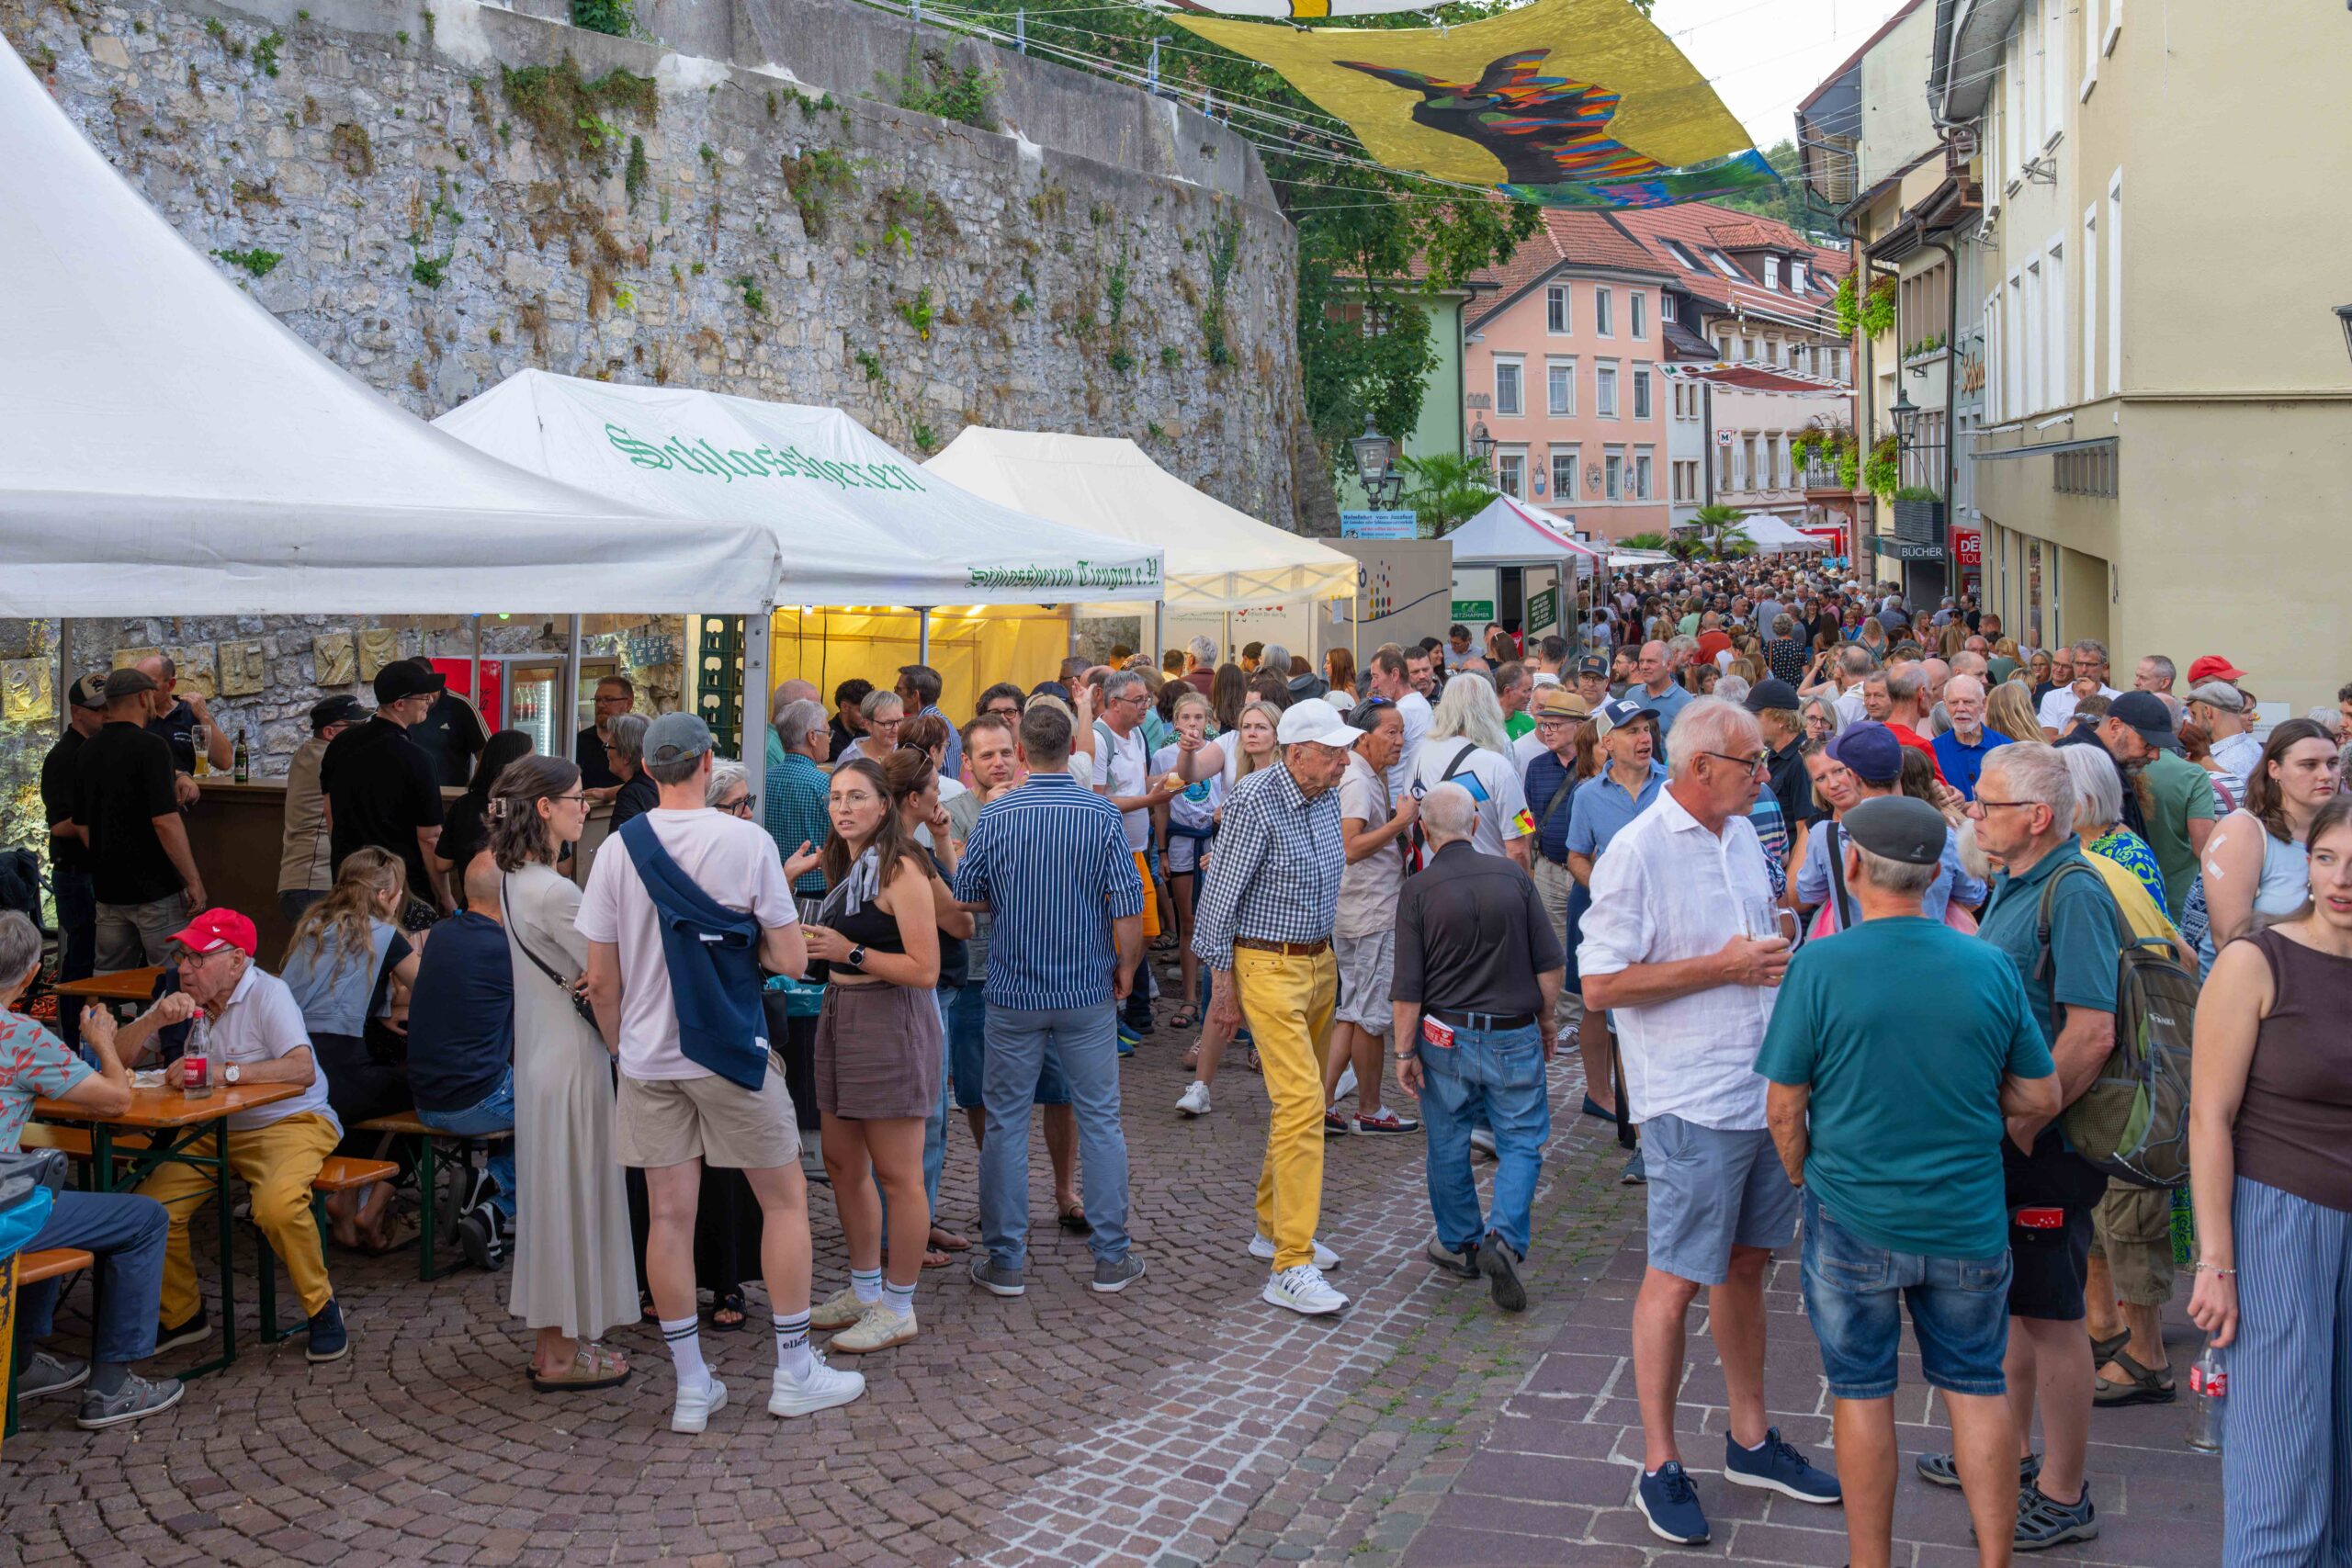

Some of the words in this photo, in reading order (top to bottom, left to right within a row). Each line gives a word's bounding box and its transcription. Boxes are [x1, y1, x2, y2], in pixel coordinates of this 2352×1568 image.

[1901, 545, 1943, 557] BÜCHER
[1961, 539, 1981, 552] DE
[1076, 559, 1134, 591] Tiengen
[1136, 558, 1159, 585] e.V.
